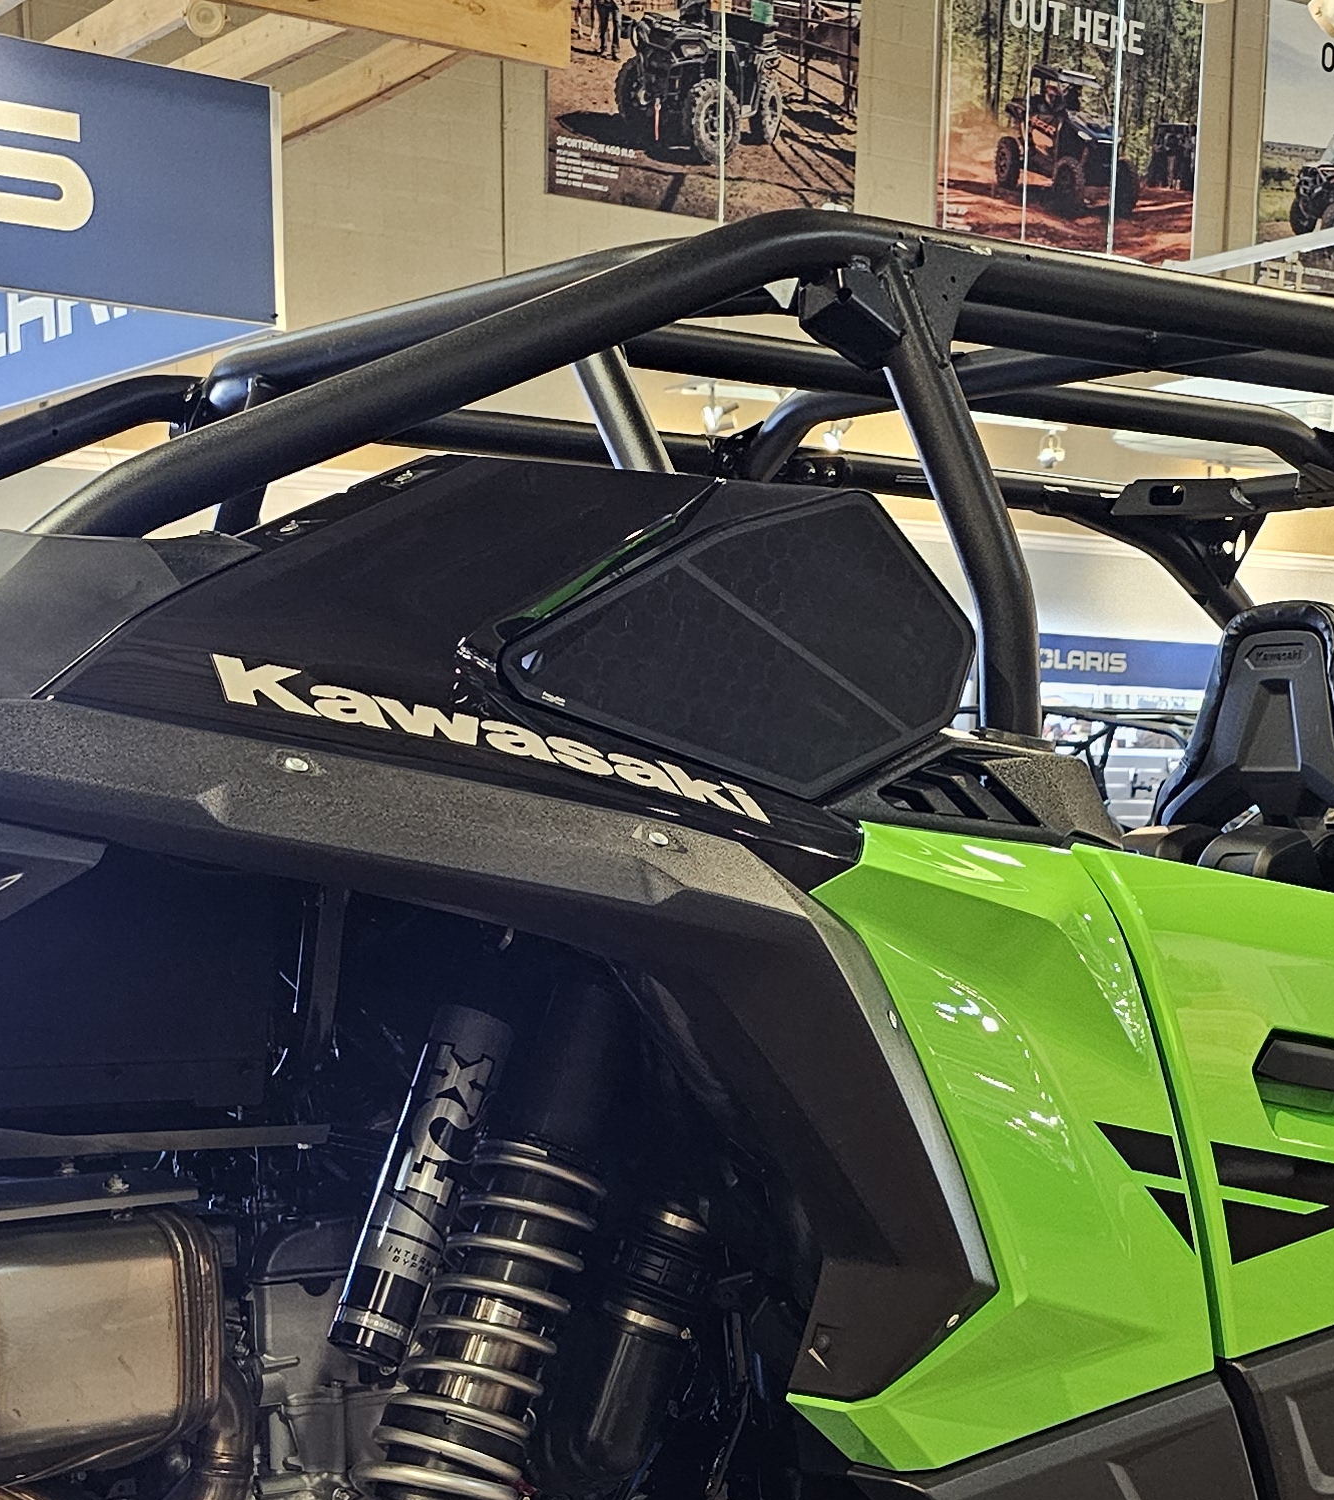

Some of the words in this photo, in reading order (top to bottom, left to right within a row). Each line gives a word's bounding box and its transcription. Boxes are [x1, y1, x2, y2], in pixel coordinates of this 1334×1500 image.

[1009, 0, 1066, 36] OUT
[1074, 6, 1146, 56] HERE
[1039, 647, 1128, 674] OLARIS
[212, 653, 771, 825] Kawasaki
[393, 1041, 495, 1208] FOX
